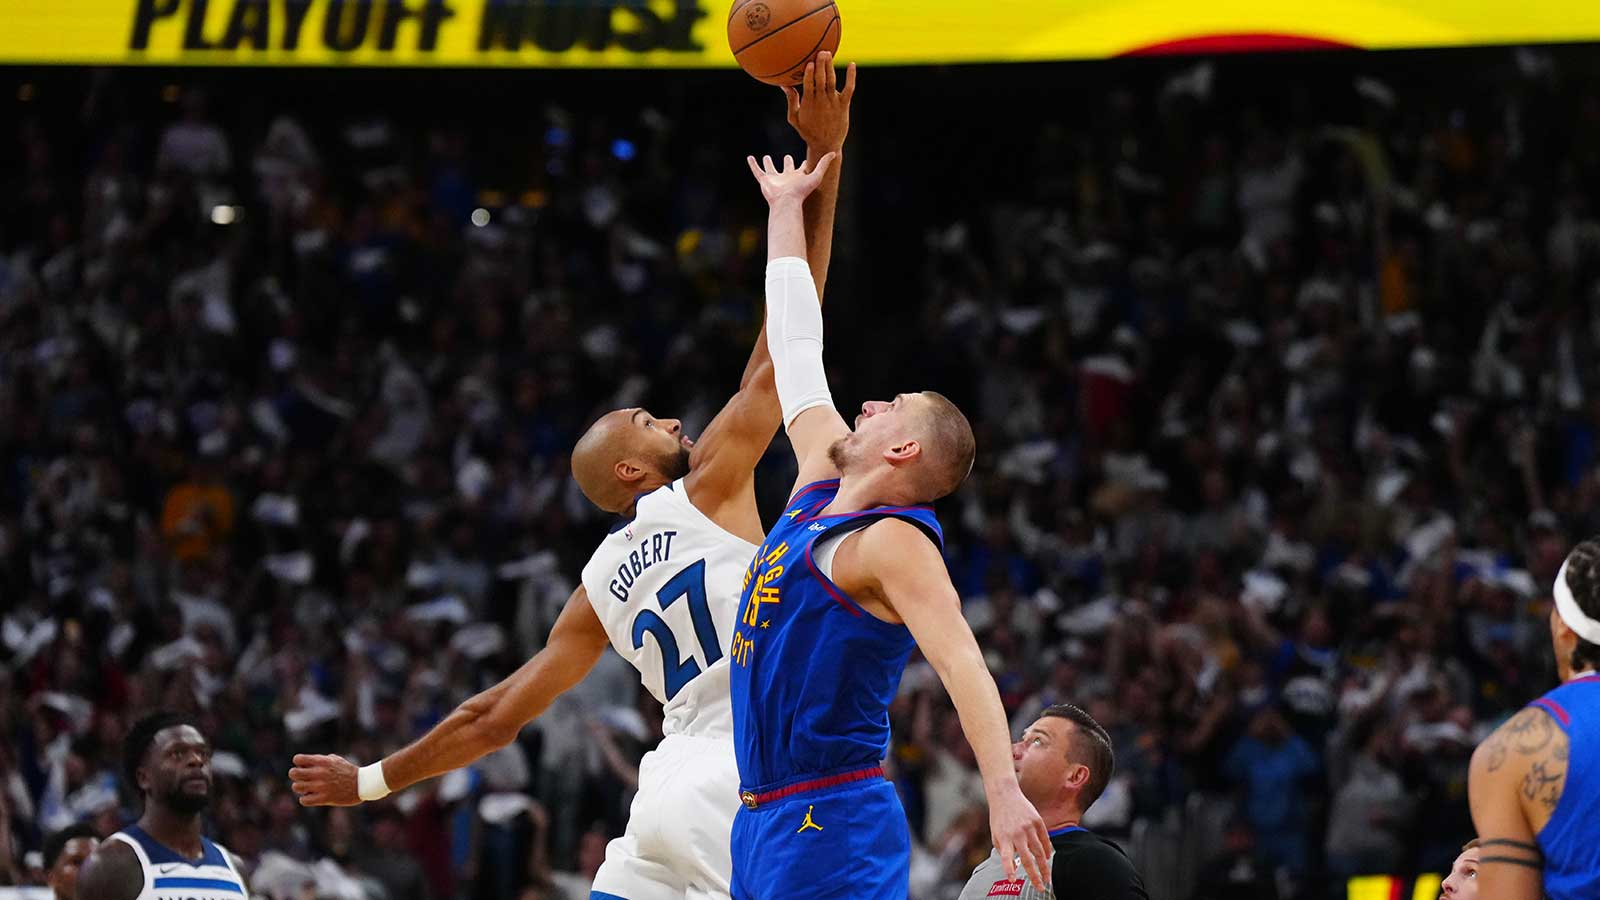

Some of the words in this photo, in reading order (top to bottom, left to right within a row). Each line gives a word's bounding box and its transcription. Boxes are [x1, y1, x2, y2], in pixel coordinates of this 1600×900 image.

[129, 0, 456, 51] PLAYOFF
[608, 530, 677, 603] GOBERT
[742, 544, 768, 592] MIL
[760, 540, 789, 603] HGH
[631, 557, 724, 702] 27
[990, 882, 1022, 894] Emirates
